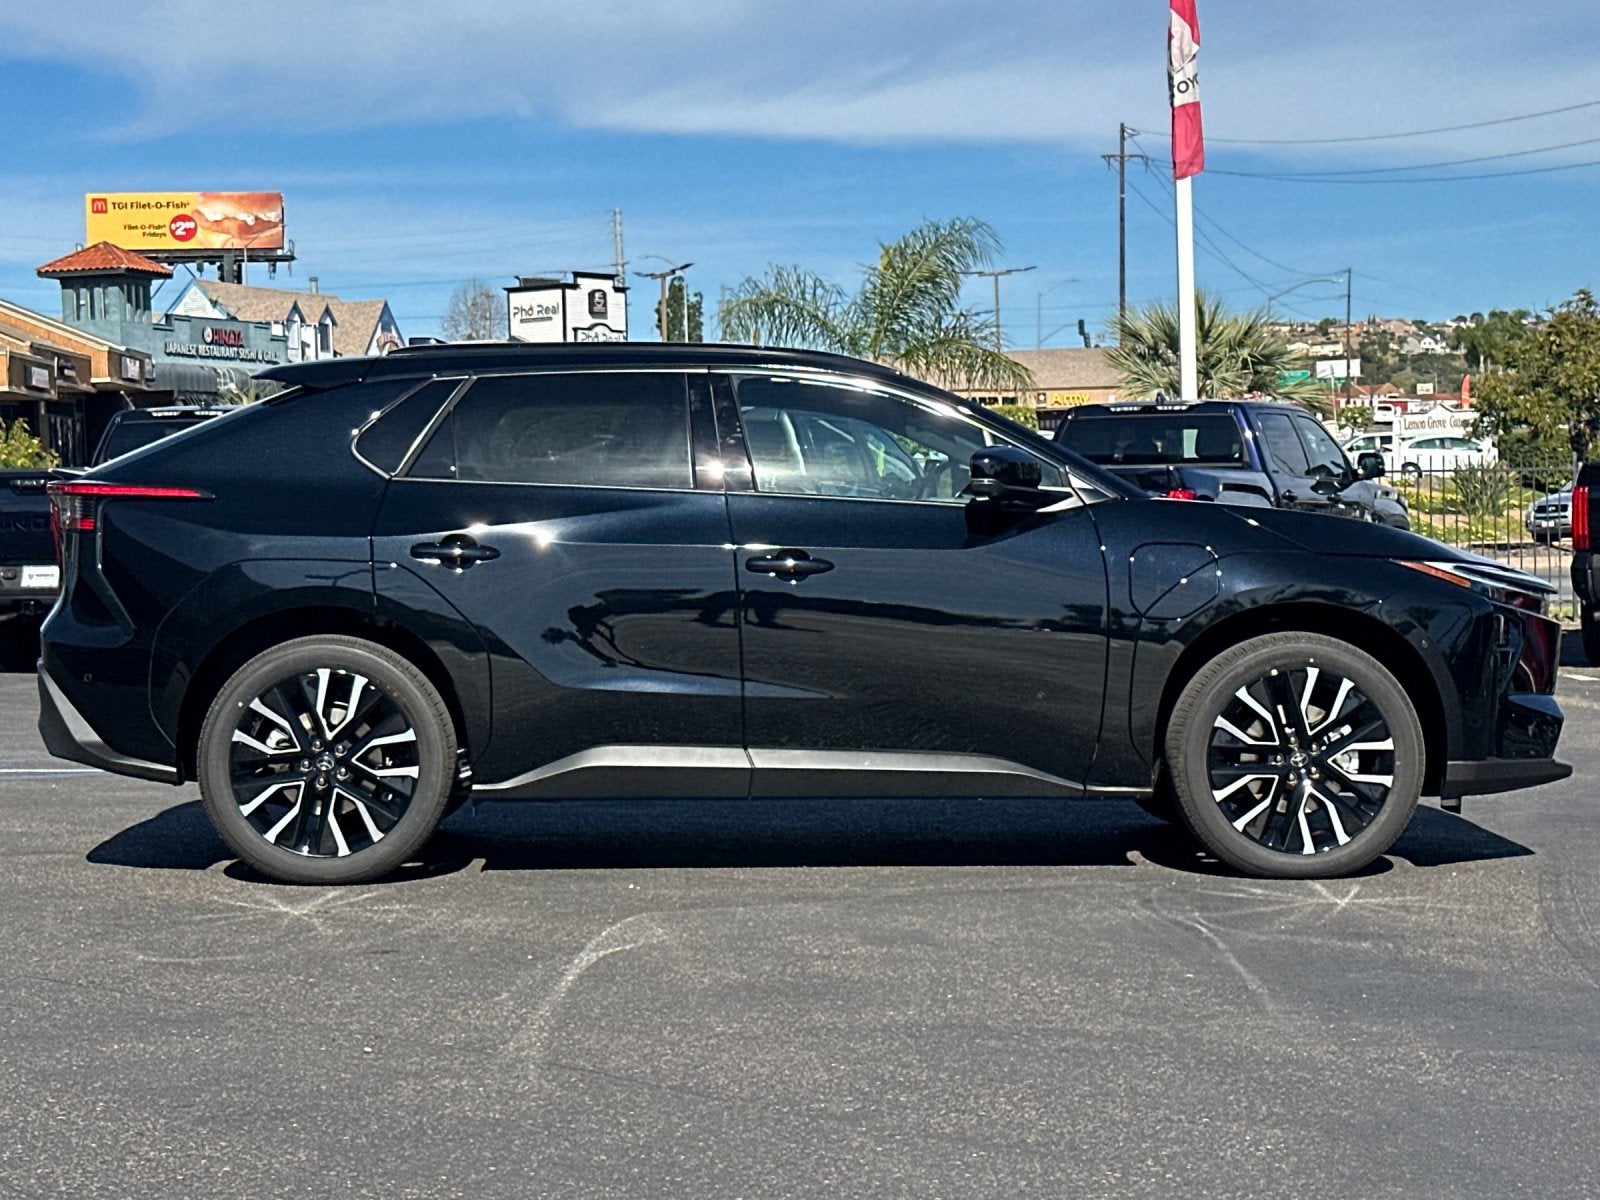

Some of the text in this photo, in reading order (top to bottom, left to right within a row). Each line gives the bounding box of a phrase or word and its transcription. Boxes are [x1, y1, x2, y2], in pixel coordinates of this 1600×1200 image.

[112, 202, 128, 210] TGI
[536, 302, 560, 317] Real
[213, 328, 245, 346] HINATA
[165, 342, 197, 356] JAPANESE
[198, 345, 238, 358] RESTAURANT
[1050, 391, 1089, 404] Army
[1403, 417, 1426, 430] Lemon
[1427, 416, 1447, 429] Grove
